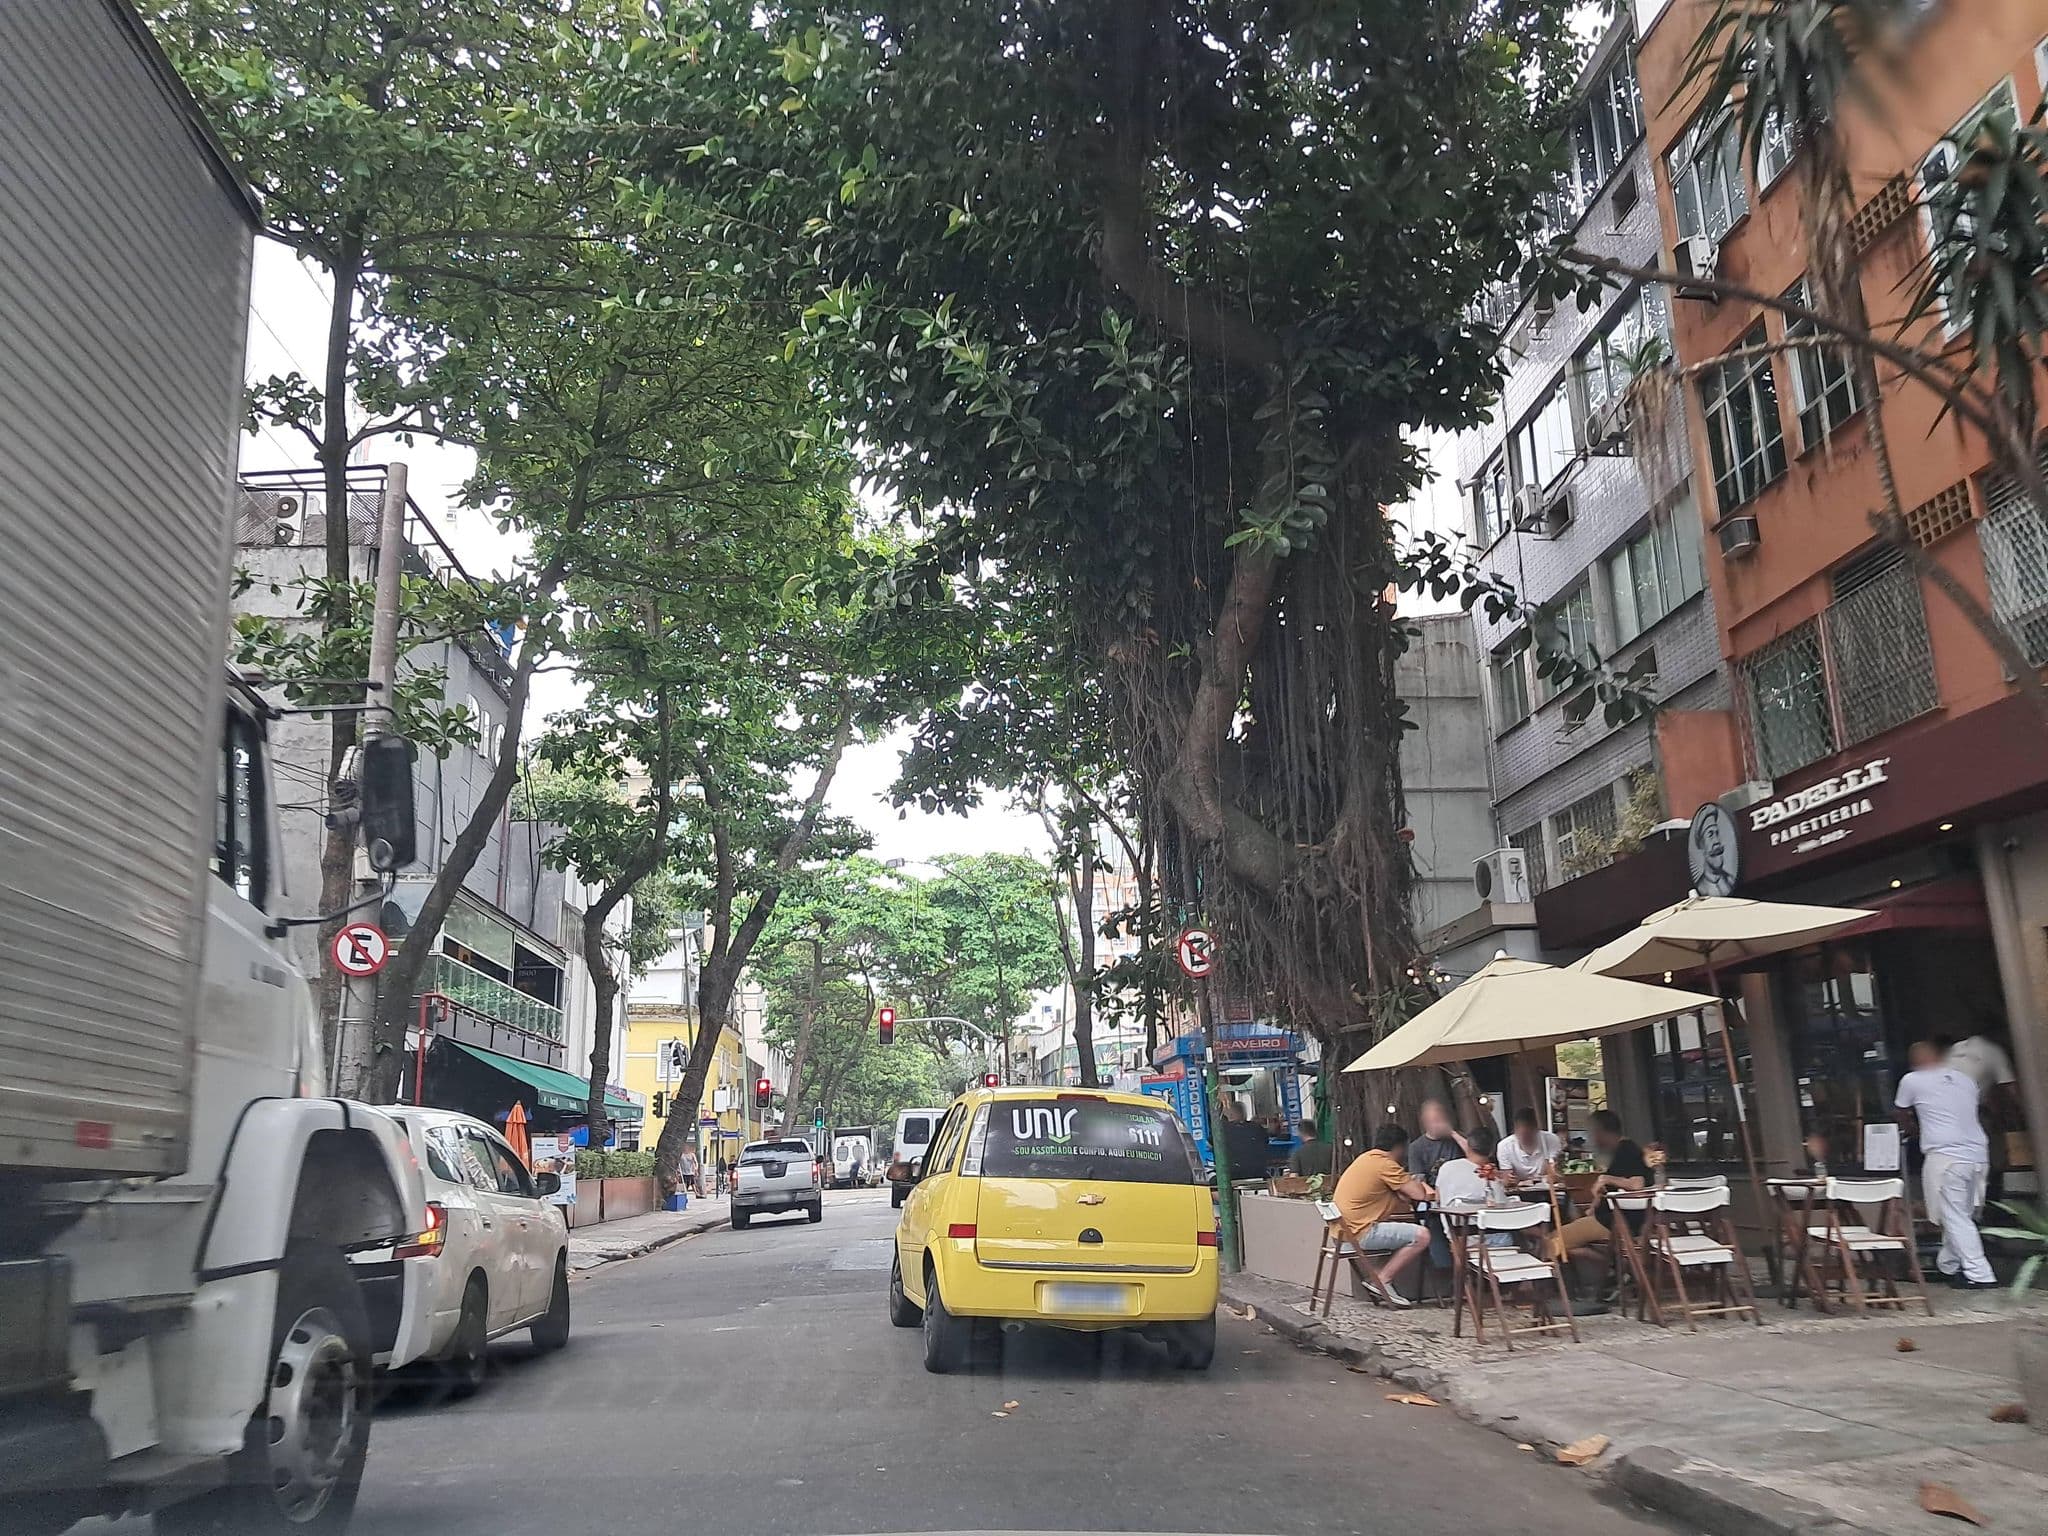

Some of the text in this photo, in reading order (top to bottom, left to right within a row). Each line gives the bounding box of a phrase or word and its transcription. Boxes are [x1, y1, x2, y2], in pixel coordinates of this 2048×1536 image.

[1749, 757, 1890, 831] PADELLI
[1770, 798, 1874, 846] PANETTERIA
[350, 934, 372, 964] E
[1188, 937, 1207, 966] E
[1014, 1146, 1030, 1155] SOU
